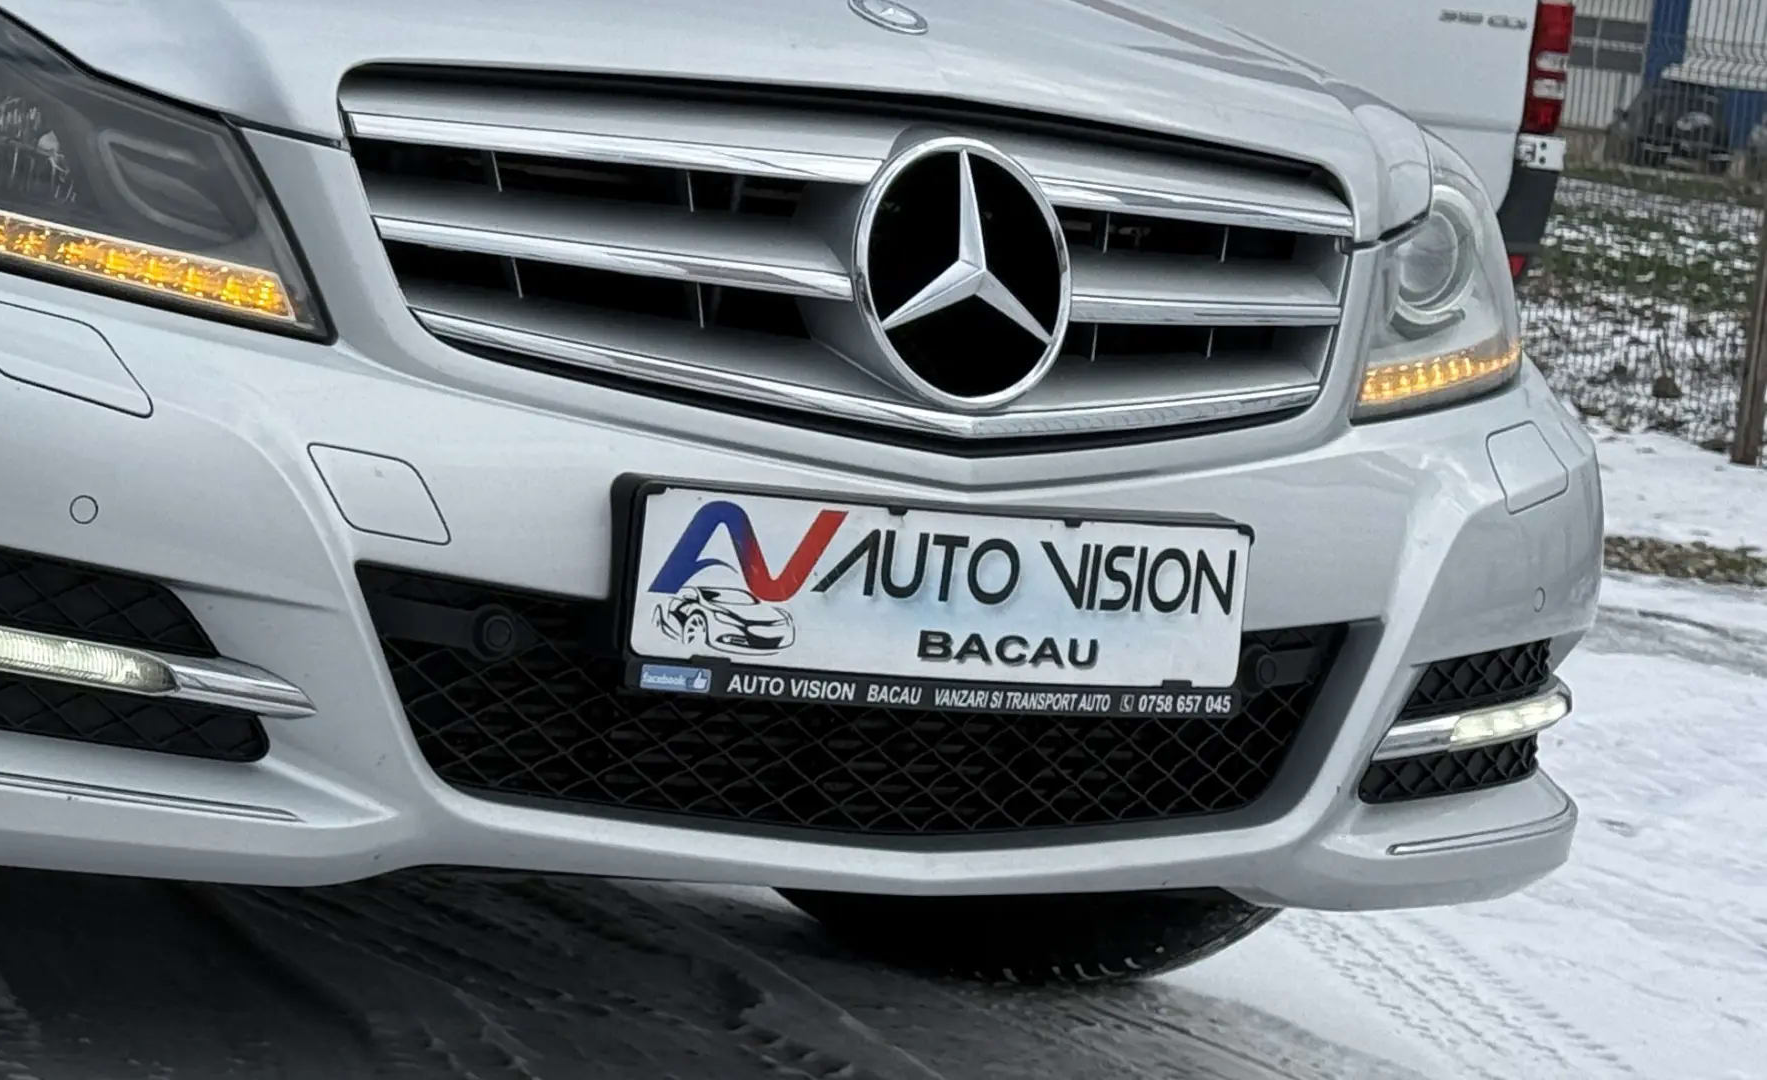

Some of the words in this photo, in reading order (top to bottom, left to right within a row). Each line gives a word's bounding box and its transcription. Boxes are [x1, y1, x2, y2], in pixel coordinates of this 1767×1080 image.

[811, 528, 1021, 606] AUTO
[1040, 540, 1238, 616] VISION
[917, 610, 1099, 668] BACAU
[727, 673, 785, 696] AUTO
[790, 678, 856, 701] VISION
[867, 683, 922, 705] BACAU
[935, 687, 989, 708] VANZARI
[990, 691, 1005, 709] SI
[1006, 692, 1077, 711] TRANSPORT
[1078, 694, 1111, 712] AUTO
[1138, 695, 1173, 713] 0758
[1177, 695, 1202, 713] 657
[1205, 696, 1231, 713] 045
